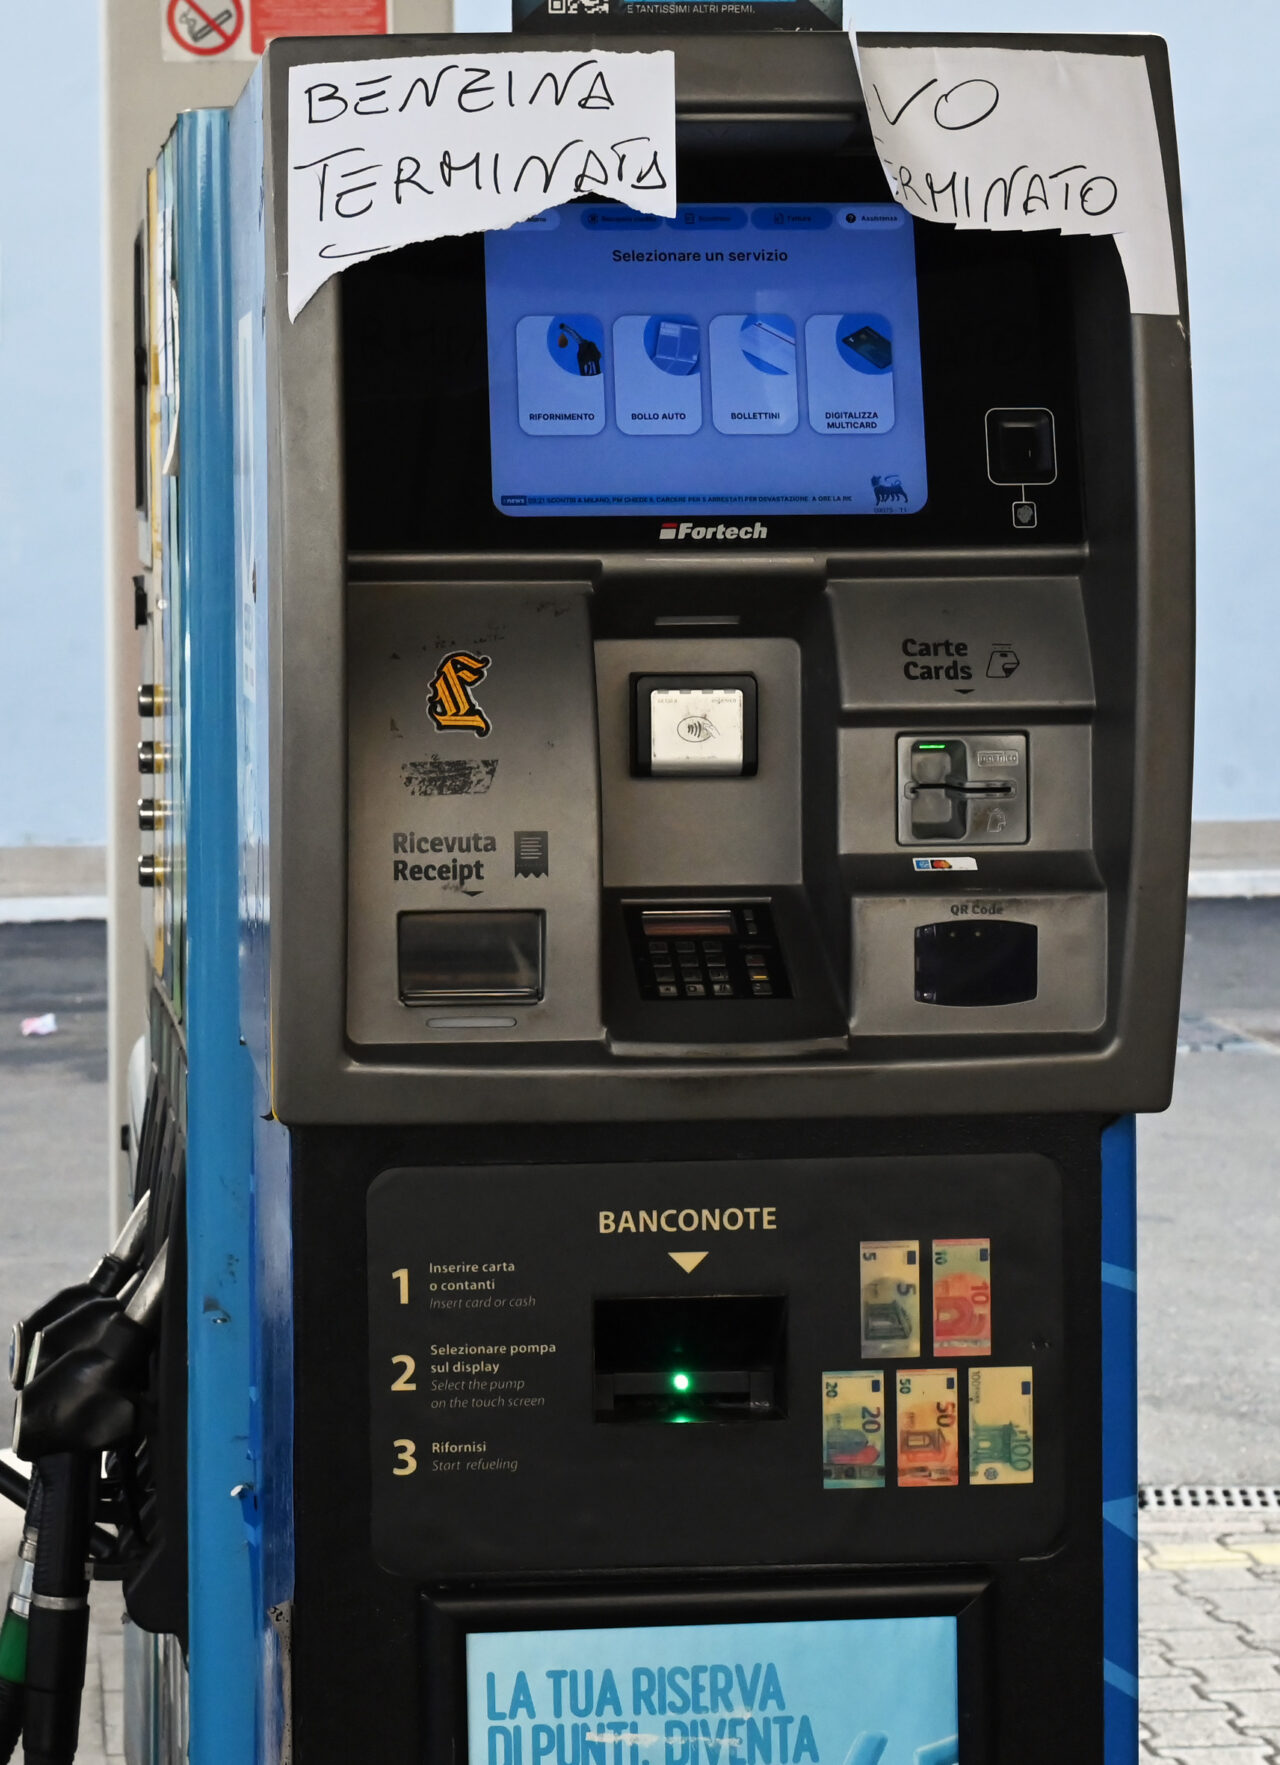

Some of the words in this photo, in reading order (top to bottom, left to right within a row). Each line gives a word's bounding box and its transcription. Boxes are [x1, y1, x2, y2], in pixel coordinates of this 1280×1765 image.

[635, 5, 691, 14] TANTISSIMI
[693, 5, 719, 14] ALTRI
[721, 5, 756, 14] PREMI.
[304, 59, 615, 124] BENZINA
[869, 77, 1000, 131] VO
[292, 137, 668, 222] TERMINATA
[880, 158, 1118, 222] RMINATO
[611, 248, 702, 264] Selezionare
[705, 252, 725, 263] un
[728, 249, 789, 263] servizio
[529, 413, 595, 421] RIFORNIMENTO
[730, 412, 781, 420] BOLLETTINI
[825, 411, 879, 419] DIGITALIZZA
[826, 421, 878, 429] MULTICARD
[677, 521, 768, 540] Fortech
[901, 638, 968, 657] Carte
[903, 660, 973, 680] Cards
[392, 832, 497, 854] Ricevuta
[393, 858, 485, 886] Receipt
[950, 904, 969, 916] QR
[971, 904, 1004, 915] Code
[598, 1207, 777, 1234] BANCONOTE
[863, 1252, 877, 1261] 5
[934, 1251, 948, 1265] 10
[429, 1262, 479, 1273] Inserire
[482, 1262, 516, 1272] carta
[391, 1268, 410, 1305] 1
[429, 1282, 438, 1291] o
[440, 1279, 496, 1291] contanti
[897, 1283, 917, 1296] 5
[970, 1281, 989, 1305] 10
[429, 1297, 463, 1309] Insert
[465, 1296, 492, 1308] card
[494, 1299, 506, 1307] or
[508, 1295, 536, 1307] cash
[430, 1343, 507, 1356] Selezionare
[510, 1344, 557, 1356] pompa
[391, 1354, 417, 1391] 2
[431, 1362, 449, 1373] sul
[452, 1361, 500, 1375] display
[431, 1379, 466, 1391] Select
[468, 1379, 488, 1390] the
[489, 1380, 525, 1392] pump
[825, 1382, 838, 1398] 20
[899, 1378, 912, 1394] 50
[430, 1400, 446, 1409] on
[449, 1397, 468, 1408] the
[471, 1396, 505, 1408] touch
[507, 1397, 546, 1408] screen
[861, 1406, 882, 1433] 20
[936, 1402, 956, 1428] 50
[432, 1441, 487, 1453] Rifornisi
[1012, 1434, 1031, 1471] 100
[392, 1438, 418, 1476] 3
[432, 1459, 460, 1471] Start
[466, 1458, 519, 1472] refueling
[486, 1670, 536, 1721] LA
[545, 1668, 623, 1719] TUA
[632, 1662, 786, 1717] RISERVA
[487, 1724, 522, 1765] DI
[664, 1714, 820, 1765] DIVENTA
